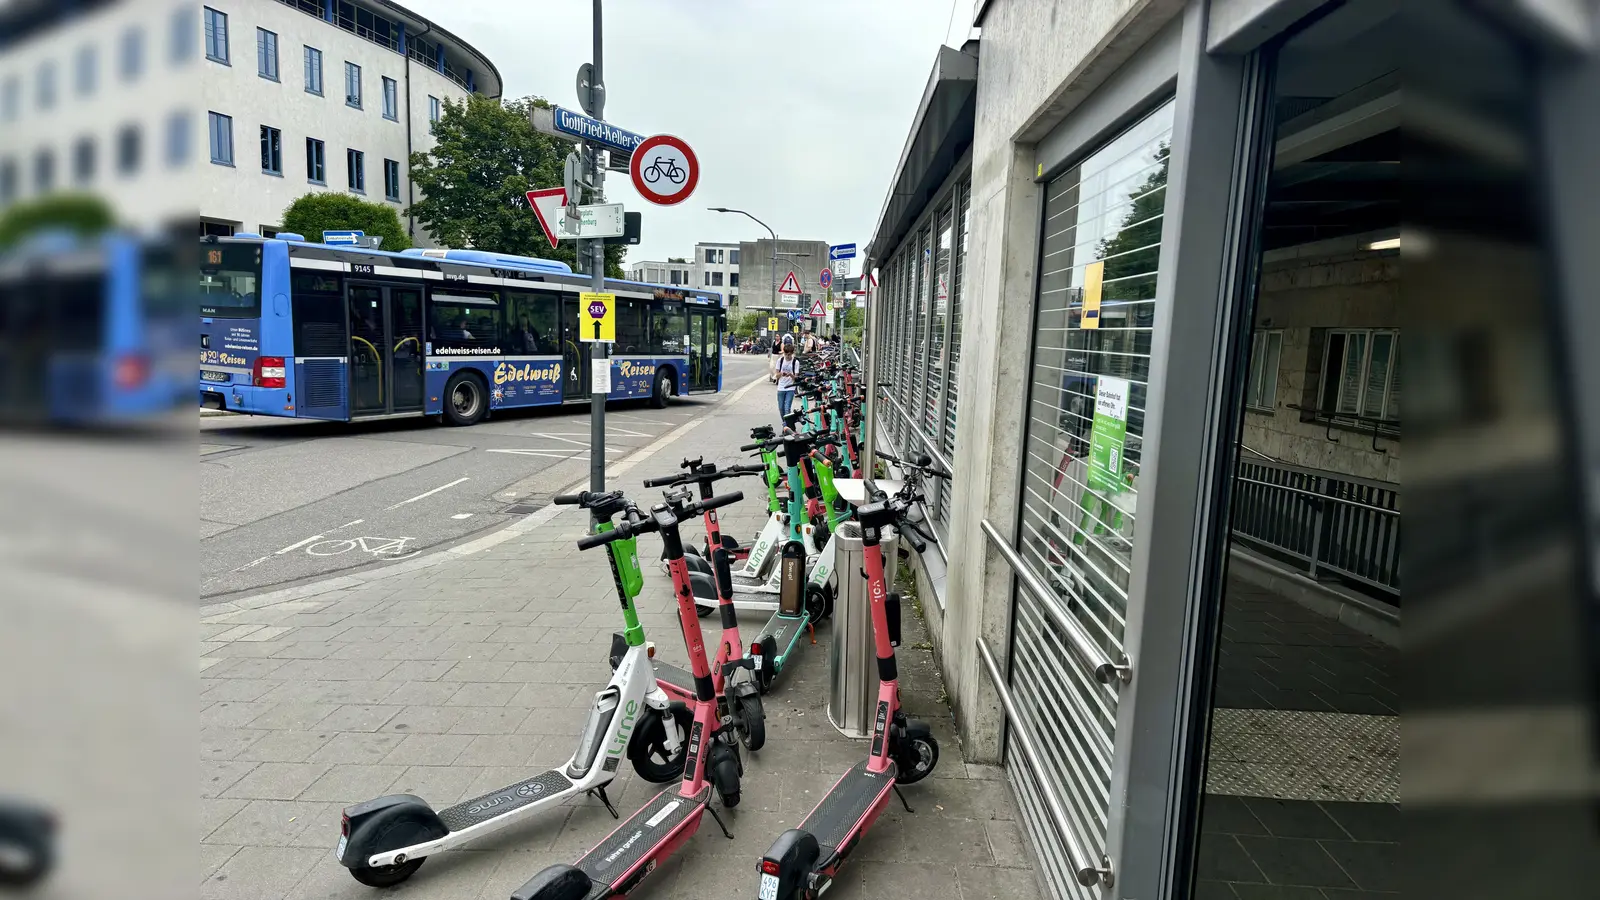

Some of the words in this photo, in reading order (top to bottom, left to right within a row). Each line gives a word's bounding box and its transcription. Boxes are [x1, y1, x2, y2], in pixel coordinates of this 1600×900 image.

[561, 111, 642, 148] Gottfried-Keller-S
[208, 251, 222, 264] 161
[354, 264, 371, 273] 9145
[446, 273, 465, 281] mvg.de
[590, 305, 604, 313] SEV
[435, 346, 501, 355] edelweiss-reisen.de
[219, 352, 246, 365] Reisen
[494, 362, 561, 385] Edelweiß
[620, 360, 656, 378] Reisen
[752, 540, 768, 569] Lime
[812, 565, 829, 587] me
[607, 699, 639, 755] Lime
[468, 795, 513, 814] Lime
[605, 845, 625, 863] Fahre
[763, 876, 777, 888] 496
